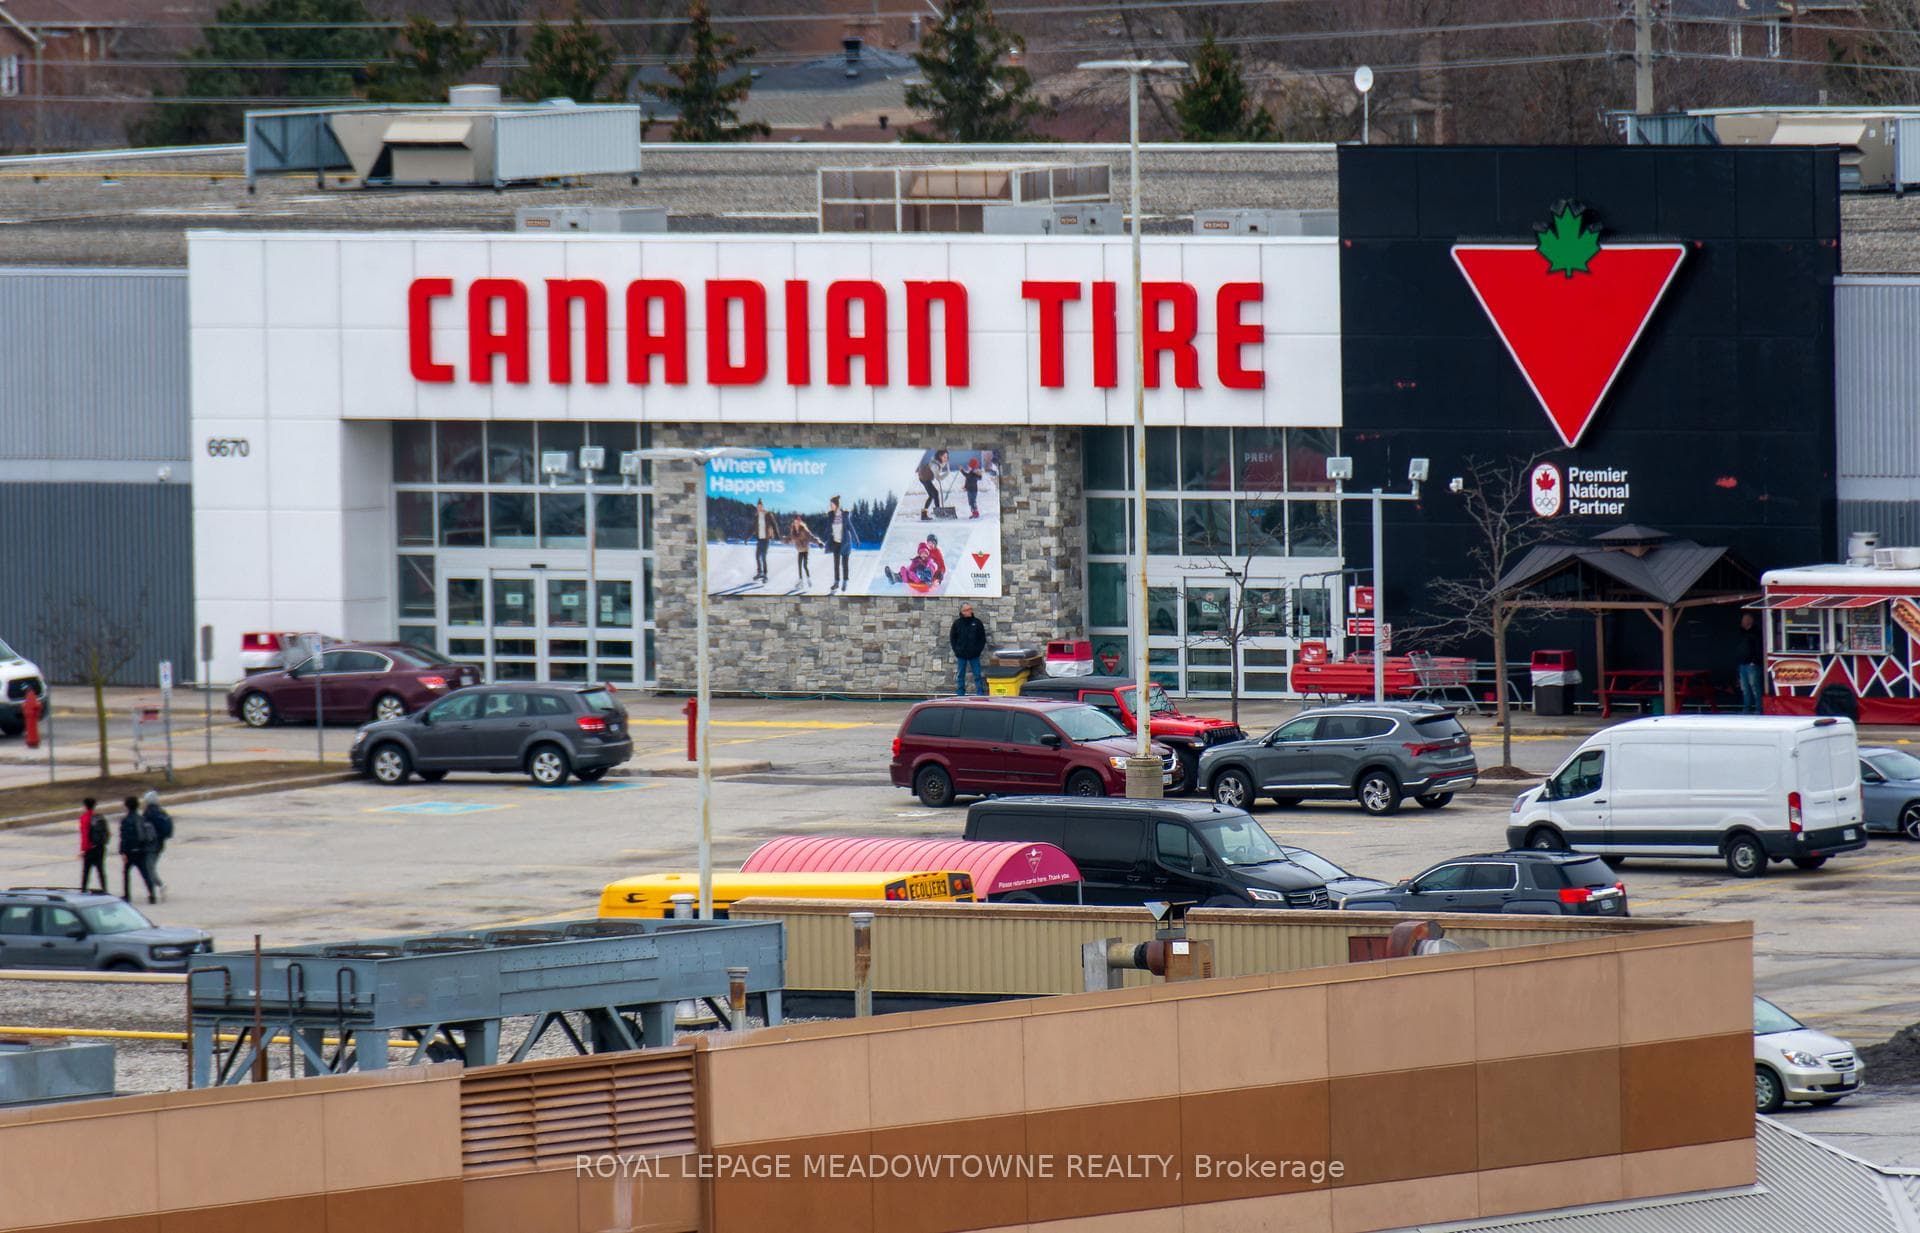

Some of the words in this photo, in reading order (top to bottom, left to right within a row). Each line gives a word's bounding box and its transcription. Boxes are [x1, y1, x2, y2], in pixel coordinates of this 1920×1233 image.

[408, 278, 970, 387] CANADIAN
[1021, 280, 1266, 390] TIRE
[207, 438, 250, 458] 6670
[710, 457, 767, 474] Where
[769, 458, 828, 475] Winter
[1568, 466, 1628, 483] Premier
[709, 475, 785, 495] Happens
[1569, 483, 1630, 499] National
[1569, 499, 1625, 515] Partner
[1013, 879, 1026, 887] return
